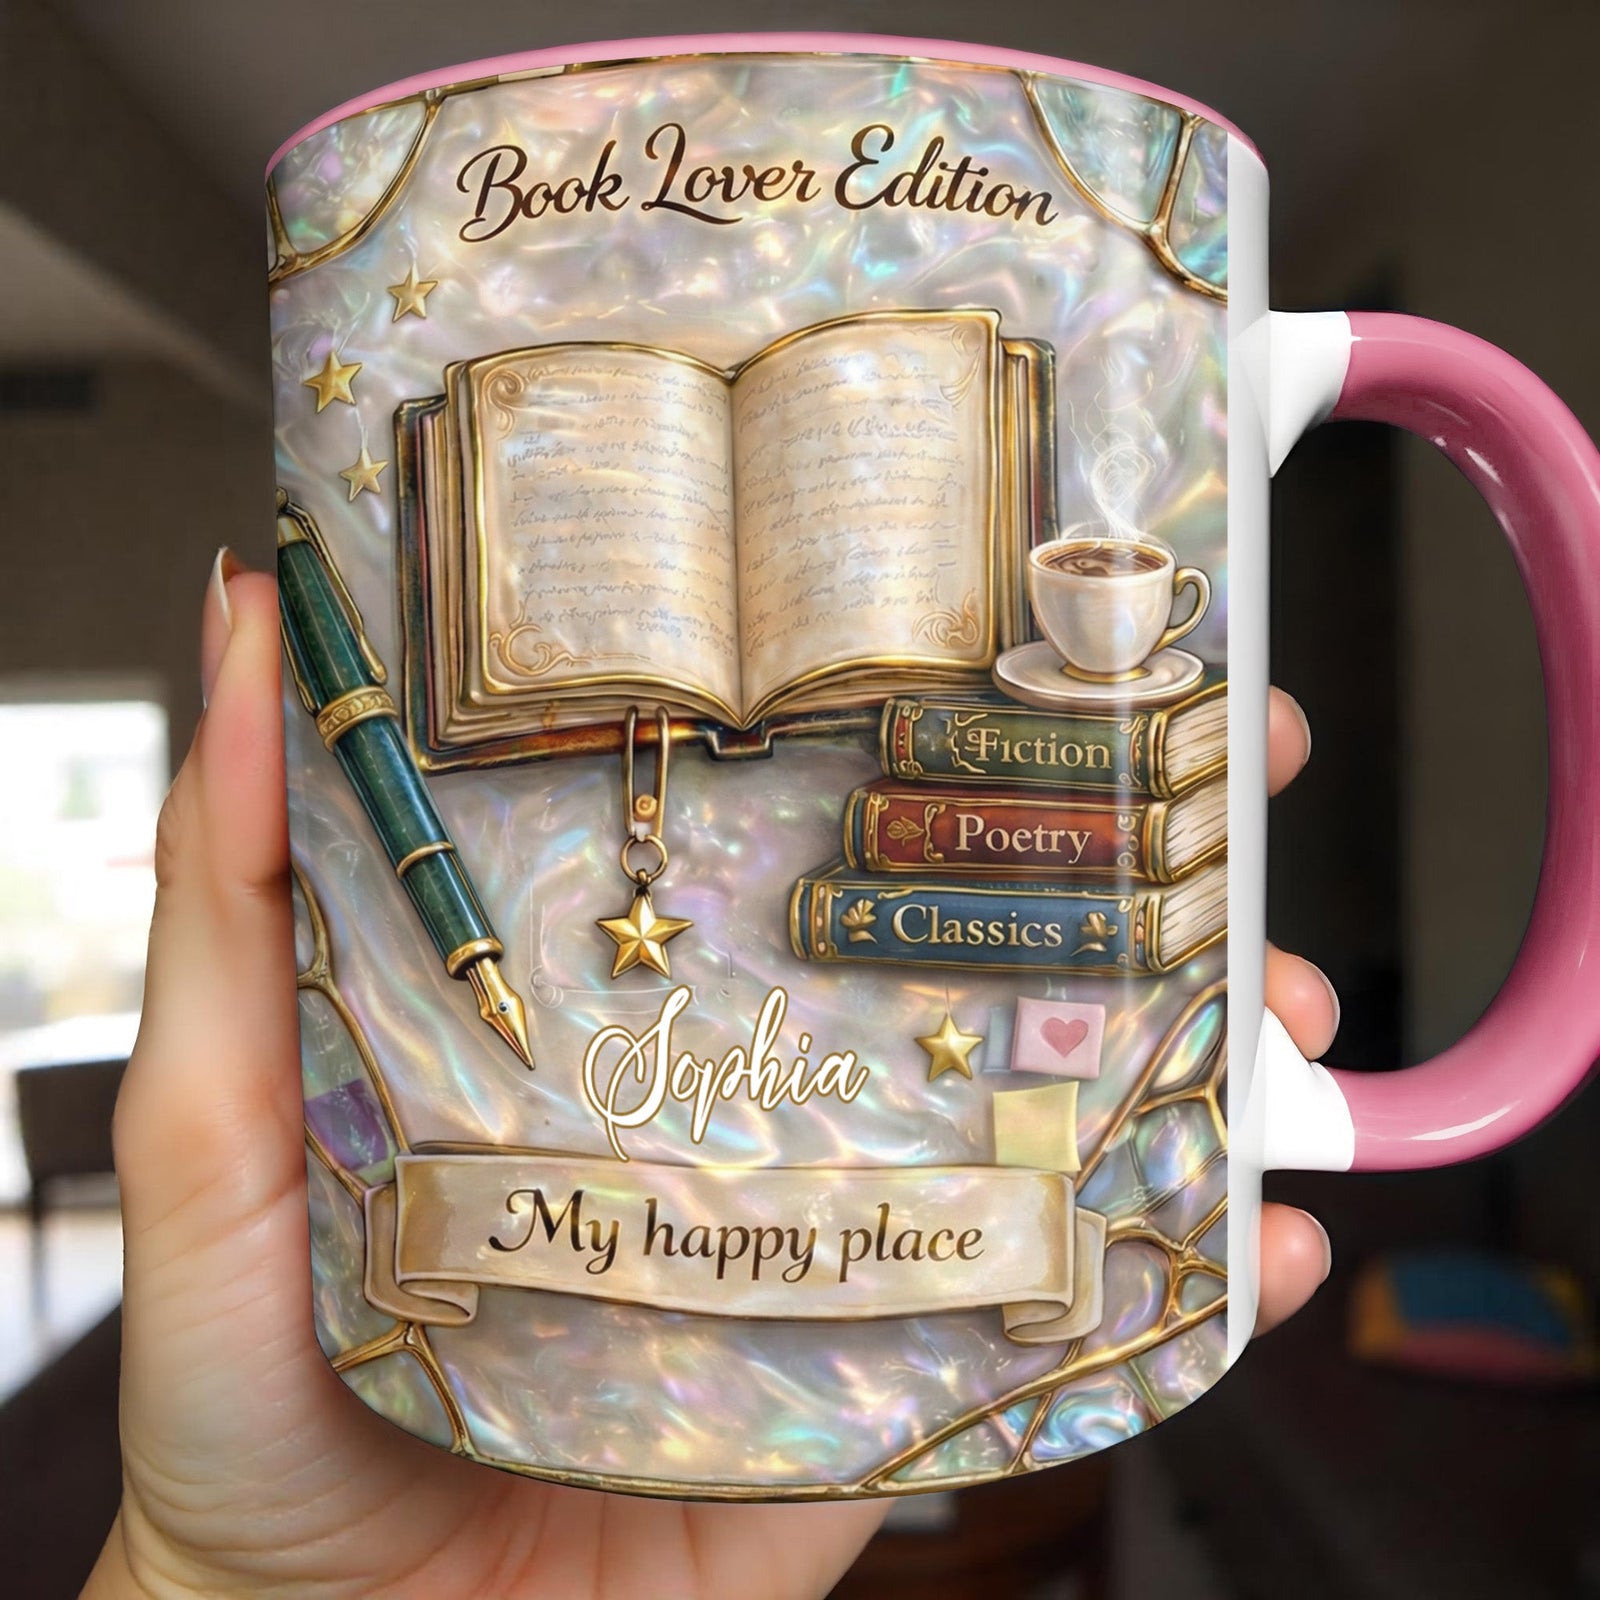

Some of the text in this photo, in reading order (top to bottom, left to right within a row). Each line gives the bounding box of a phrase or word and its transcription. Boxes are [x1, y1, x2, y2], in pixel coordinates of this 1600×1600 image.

[457, 122, 1060, 242] Book Lover Edition
[974, 727, 1112, 769] Fiction
[955, 814, 1092, 864] Poetry
[892, 904, 1063, 948] Classics
[582, 984, 870, 1163] Sophia
[488, 1188, 985, 1283] My happy place
